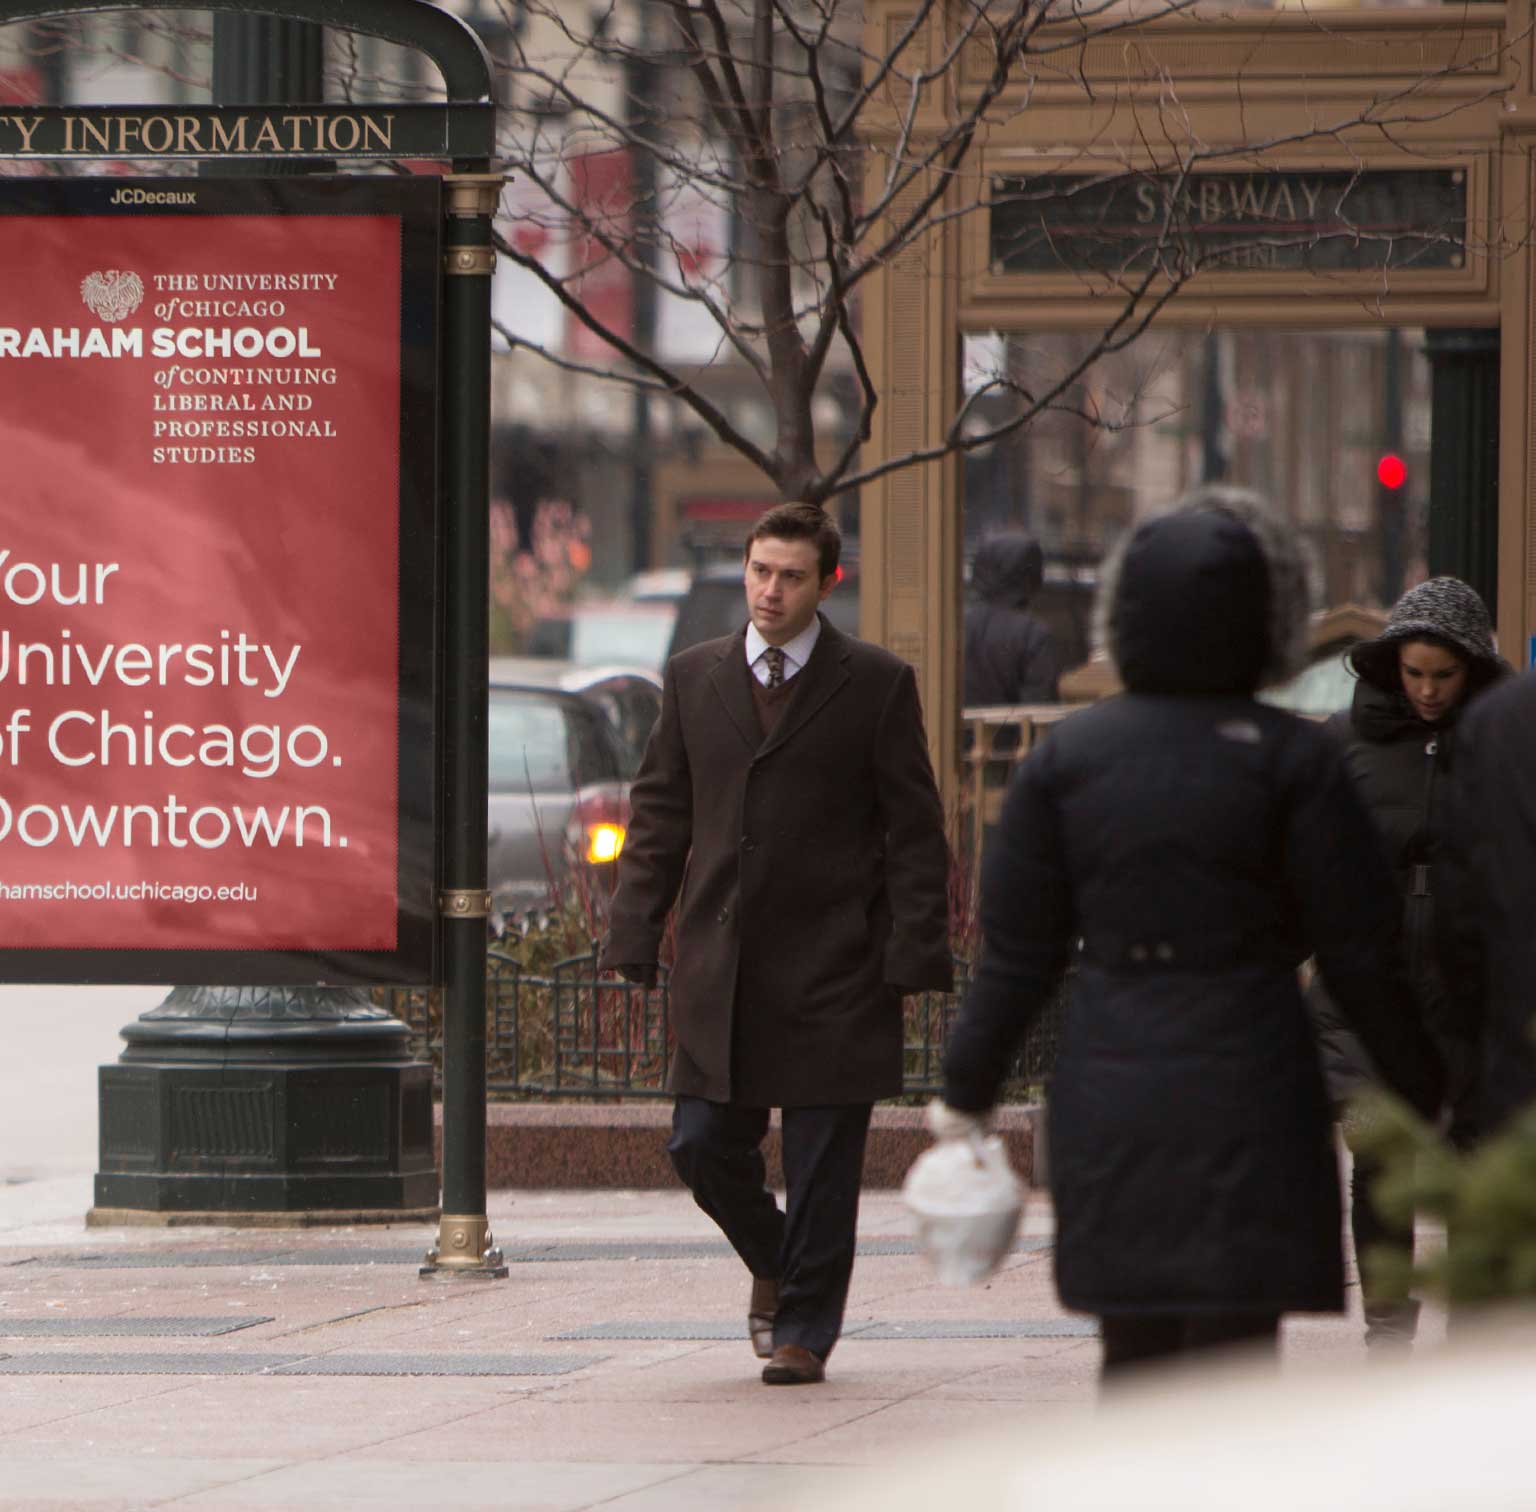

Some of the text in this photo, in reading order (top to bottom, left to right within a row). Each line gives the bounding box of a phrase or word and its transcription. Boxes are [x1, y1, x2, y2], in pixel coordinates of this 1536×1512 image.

[62, 114, 395, 152] INFORMATION
[110, 188, 197, 206] JCDecaux
[153, 274, 339, 291] THE UNIVERSITY
[151, 326, 321, 358] SCHOOL
[153, 394, 313, 411] LIBERAL AND
[153, 420, 337, 438] PROFESSIONAL
[153, 446, 256, 464] STUDIES
[47, 709, 344, 778] Chicago.
